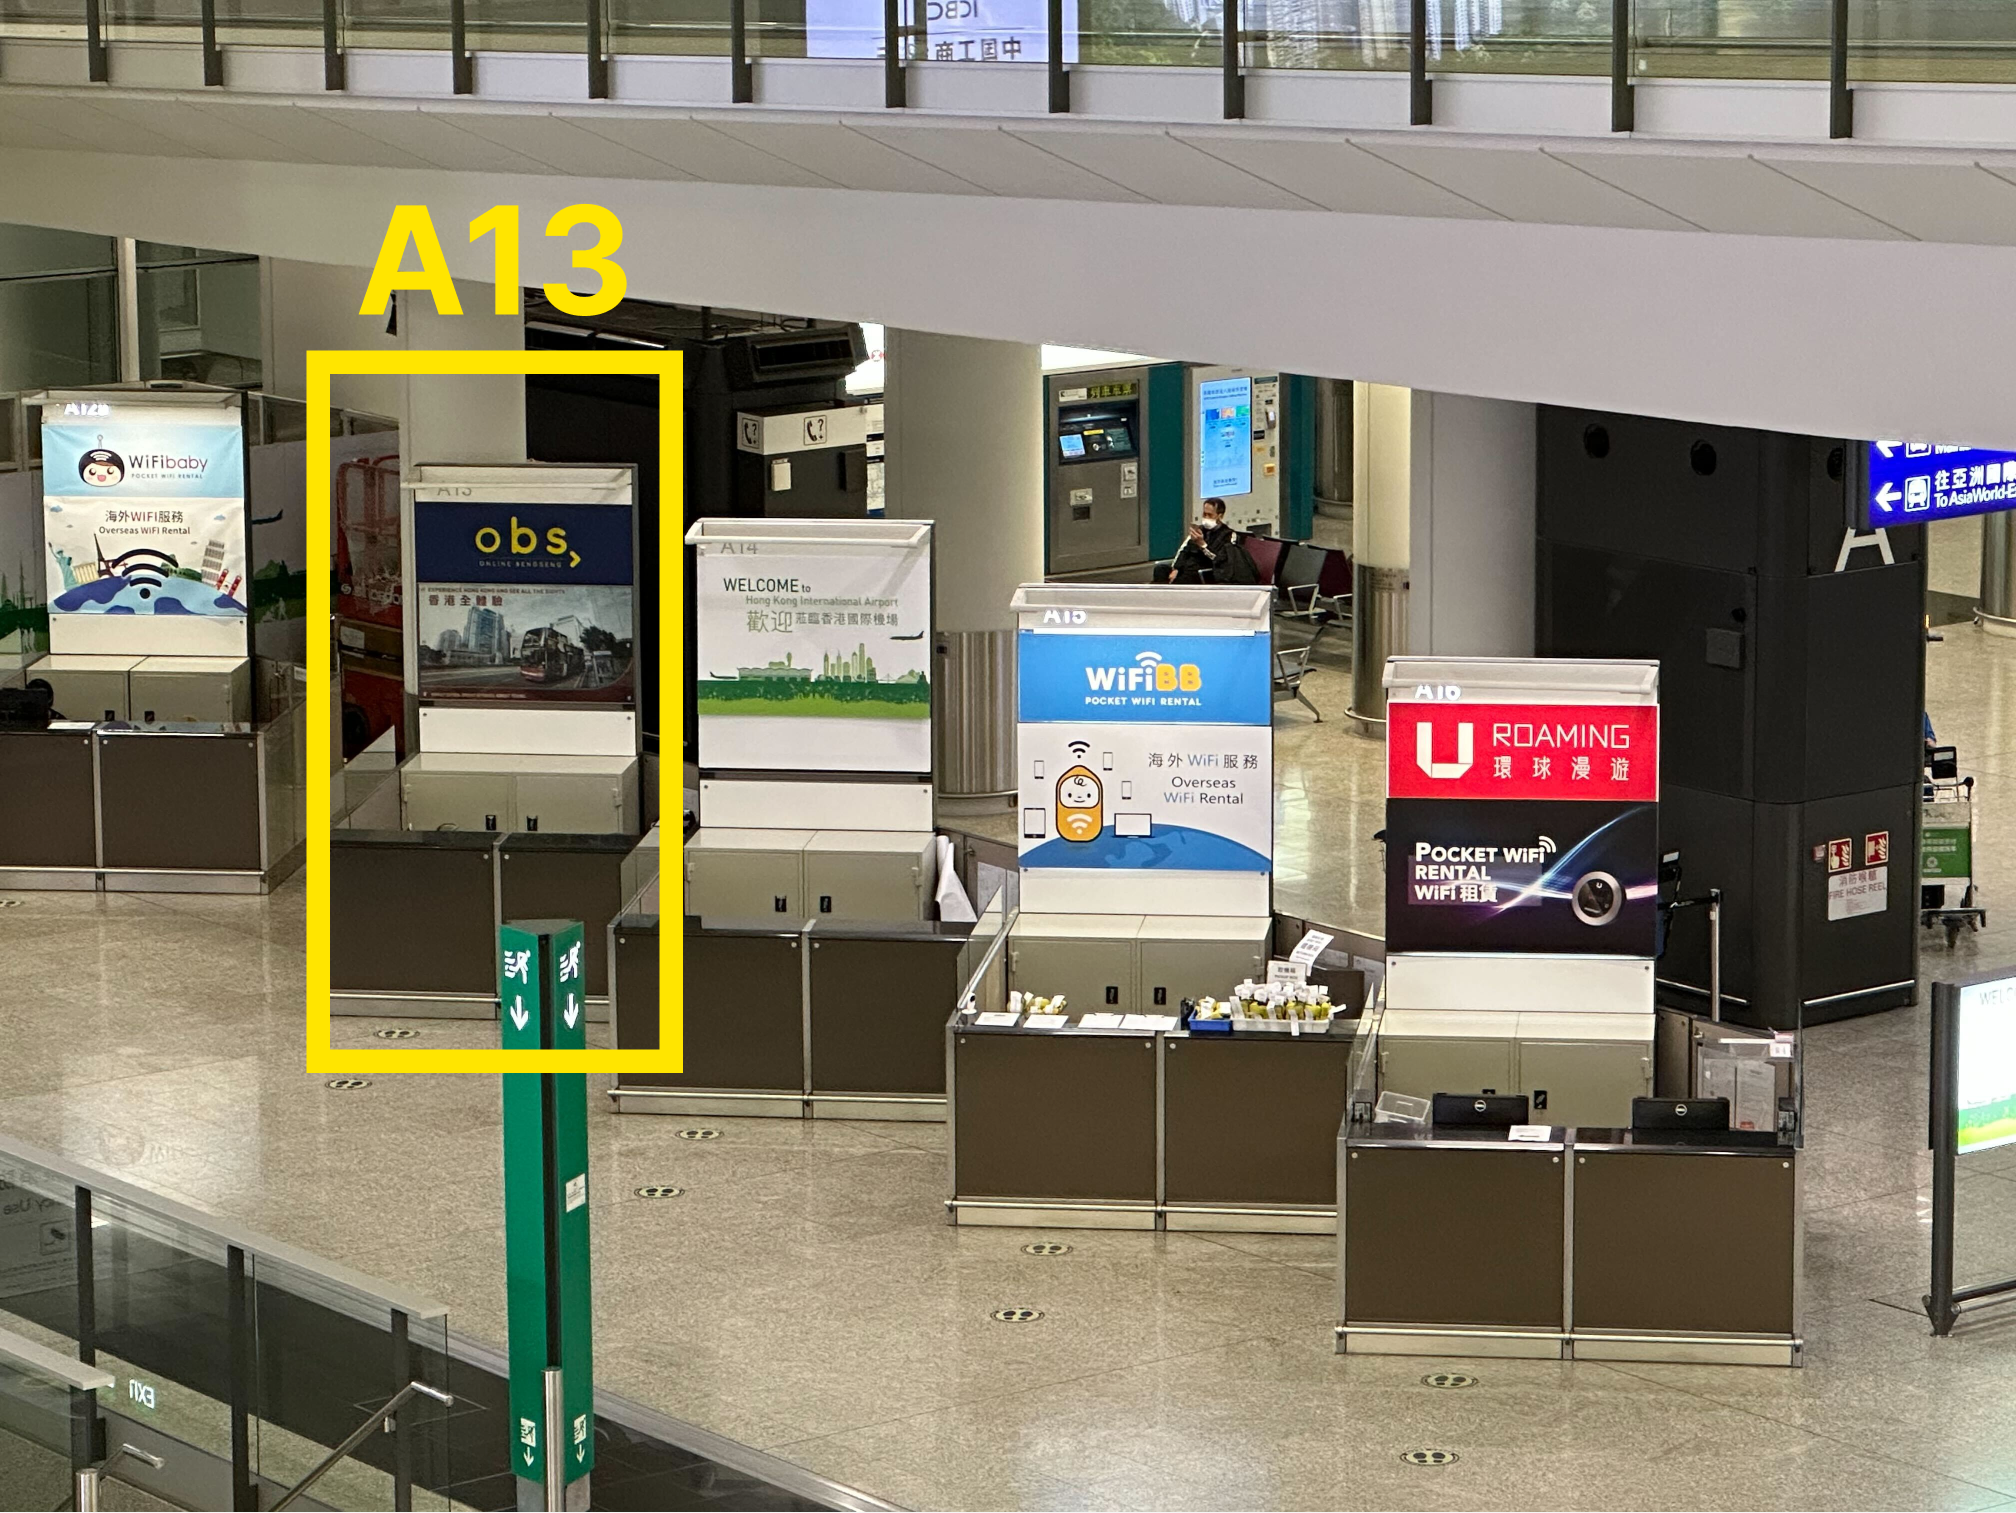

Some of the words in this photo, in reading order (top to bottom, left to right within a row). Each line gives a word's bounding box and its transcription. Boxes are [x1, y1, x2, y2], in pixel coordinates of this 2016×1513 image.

[129, 454, 208, 472] WiFibaby
[1934, 492, 1948, 508] To
[105, 510, 184, 523] 海外WIFI服務
[98, 526, 139, 535] Overseas
[162, 526, 191, 535] Rental
[475, 516, 567, 555] obs
[479, 560, 511, 568] ONLINE
[723, 578, 799, 593] WELCOME
[801, 584, 811, 593] to
[746, 595, 770, 607] Hong
[773, 596, 797, 608] Kong
[800, 596, 861, 607] International
[864, 597, 898, 608] Airport
[746, 610, 793, 633] 歡迎
[1085, 664, 1202, 691] WiFiBB
[1085, 696, 1127, 706] POCKET
[1131, 697, 1156, 706] WIFI
[1160, 697, 1202, 706] RENTAL
[1416, 722, 1474, 779] U
[1493, 723, 1630, 749] ROAMING
[1148, 752, 1183, 768] 海外
[1187, 754, 1219, 767] WiFi
[1223, 754, 1258, 770] 服務
[1493, 755, 1630, 781] 環球漫遊
[1171, 776, 1236, 789] Overseas
[1163, 792, 1194, 804] WiFi
[1200, 792, 1243, 804] Rental
[1415, 842, 1498, 863] POCKET
[1503, 846, 1545, 863] WiFi
[1415, 865, 1491, 881] RENTAL
[1414, 884, 1456, 901] WiFi
[1828, 889, 1845, 900] FIRE
[1846, 884, 1867, 896] HOSE
[1868, 881, 1887, 892] REEL
[1979, 986, 2016, 1006] WELC
